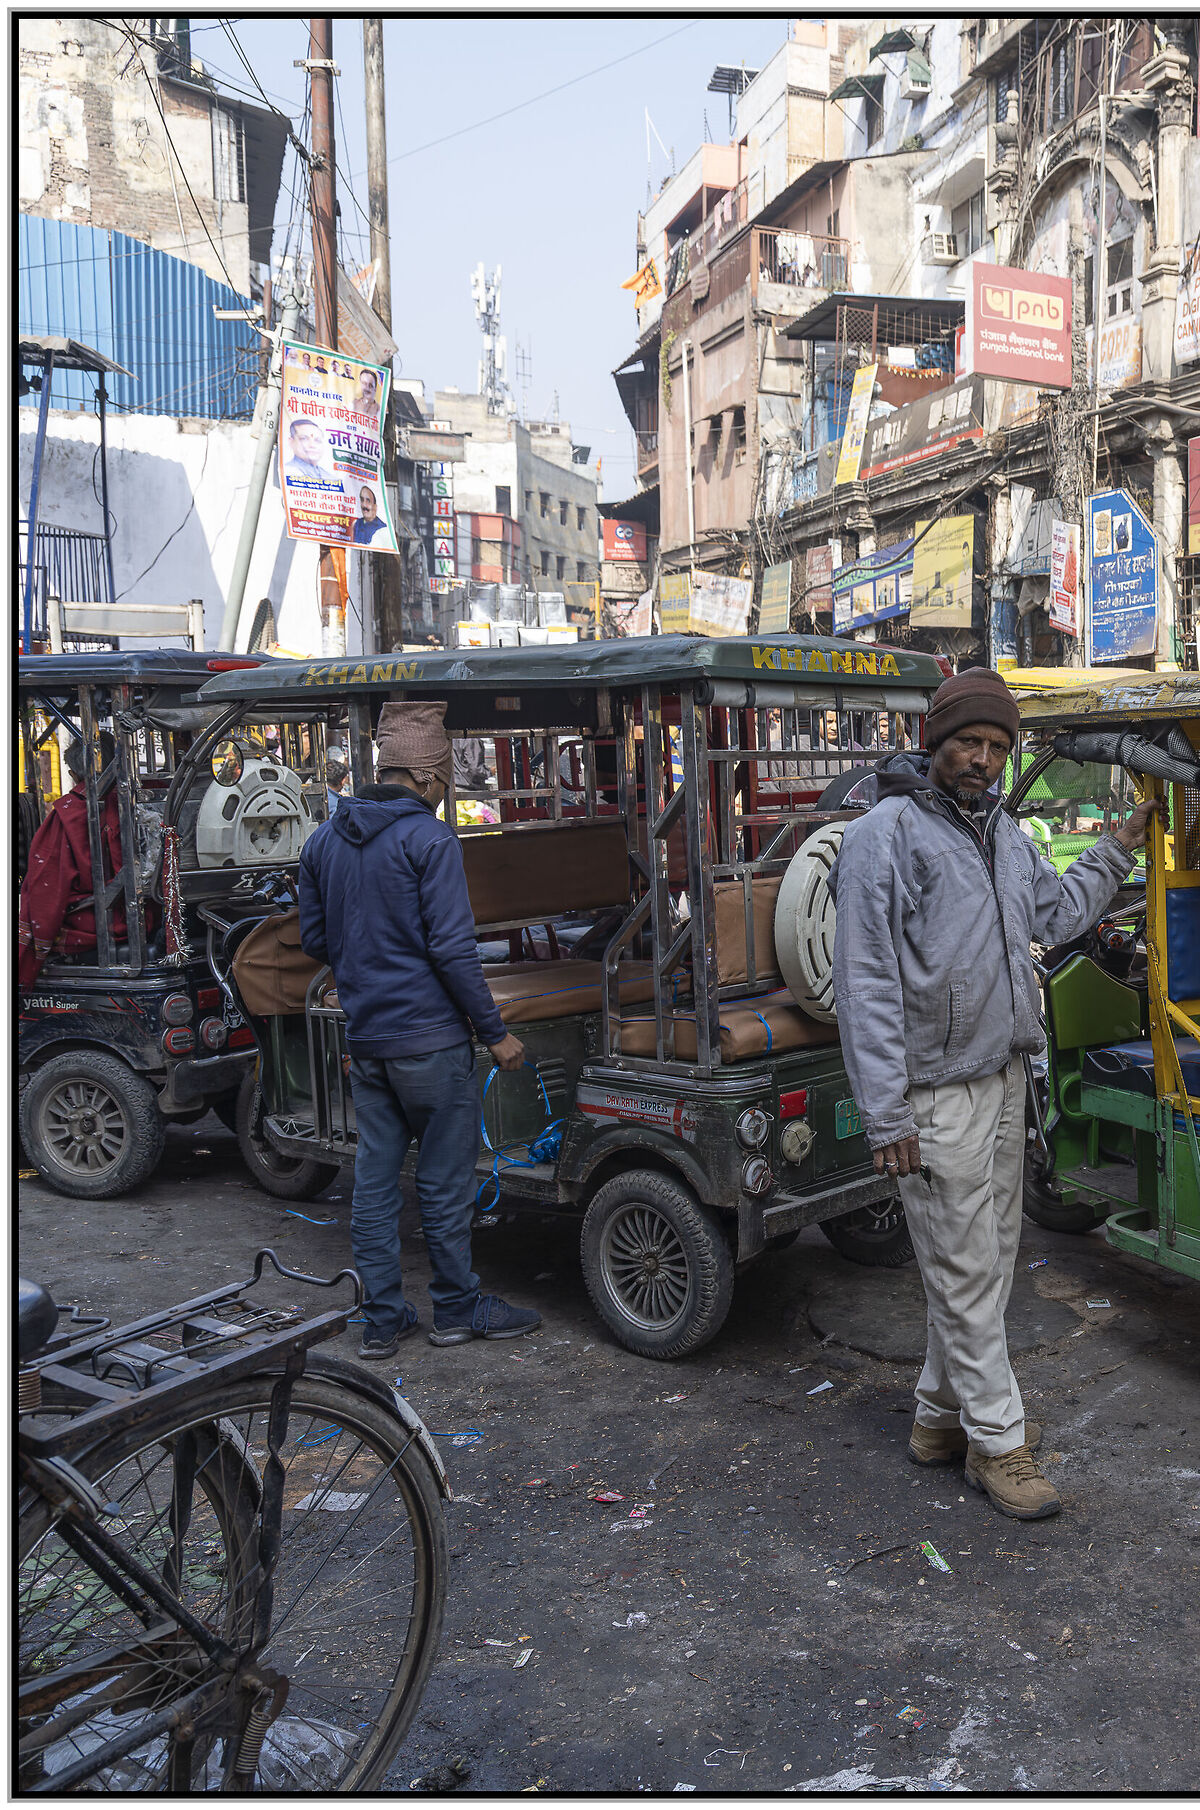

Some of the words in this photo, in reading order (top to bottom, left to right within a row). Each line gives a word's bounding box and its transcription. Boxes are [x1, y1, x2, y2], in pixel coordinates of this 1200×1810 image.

[1017, 299, 1059, 320] pnb
[980, 341, 1009, 354] punjab
[1010, 346, 1043, 360] national
[1044, 350, 1064, 363] bank
[326, 428, 352, 450] जन
[752, 646, 901, 676] KHANNA
[304, 661, 424, 686] KHANN
[23, 997, 54, 1010] yatri
[55, 1001, 79, 1010] Super
[641, 1101, 668, 1114] EXPRESS
